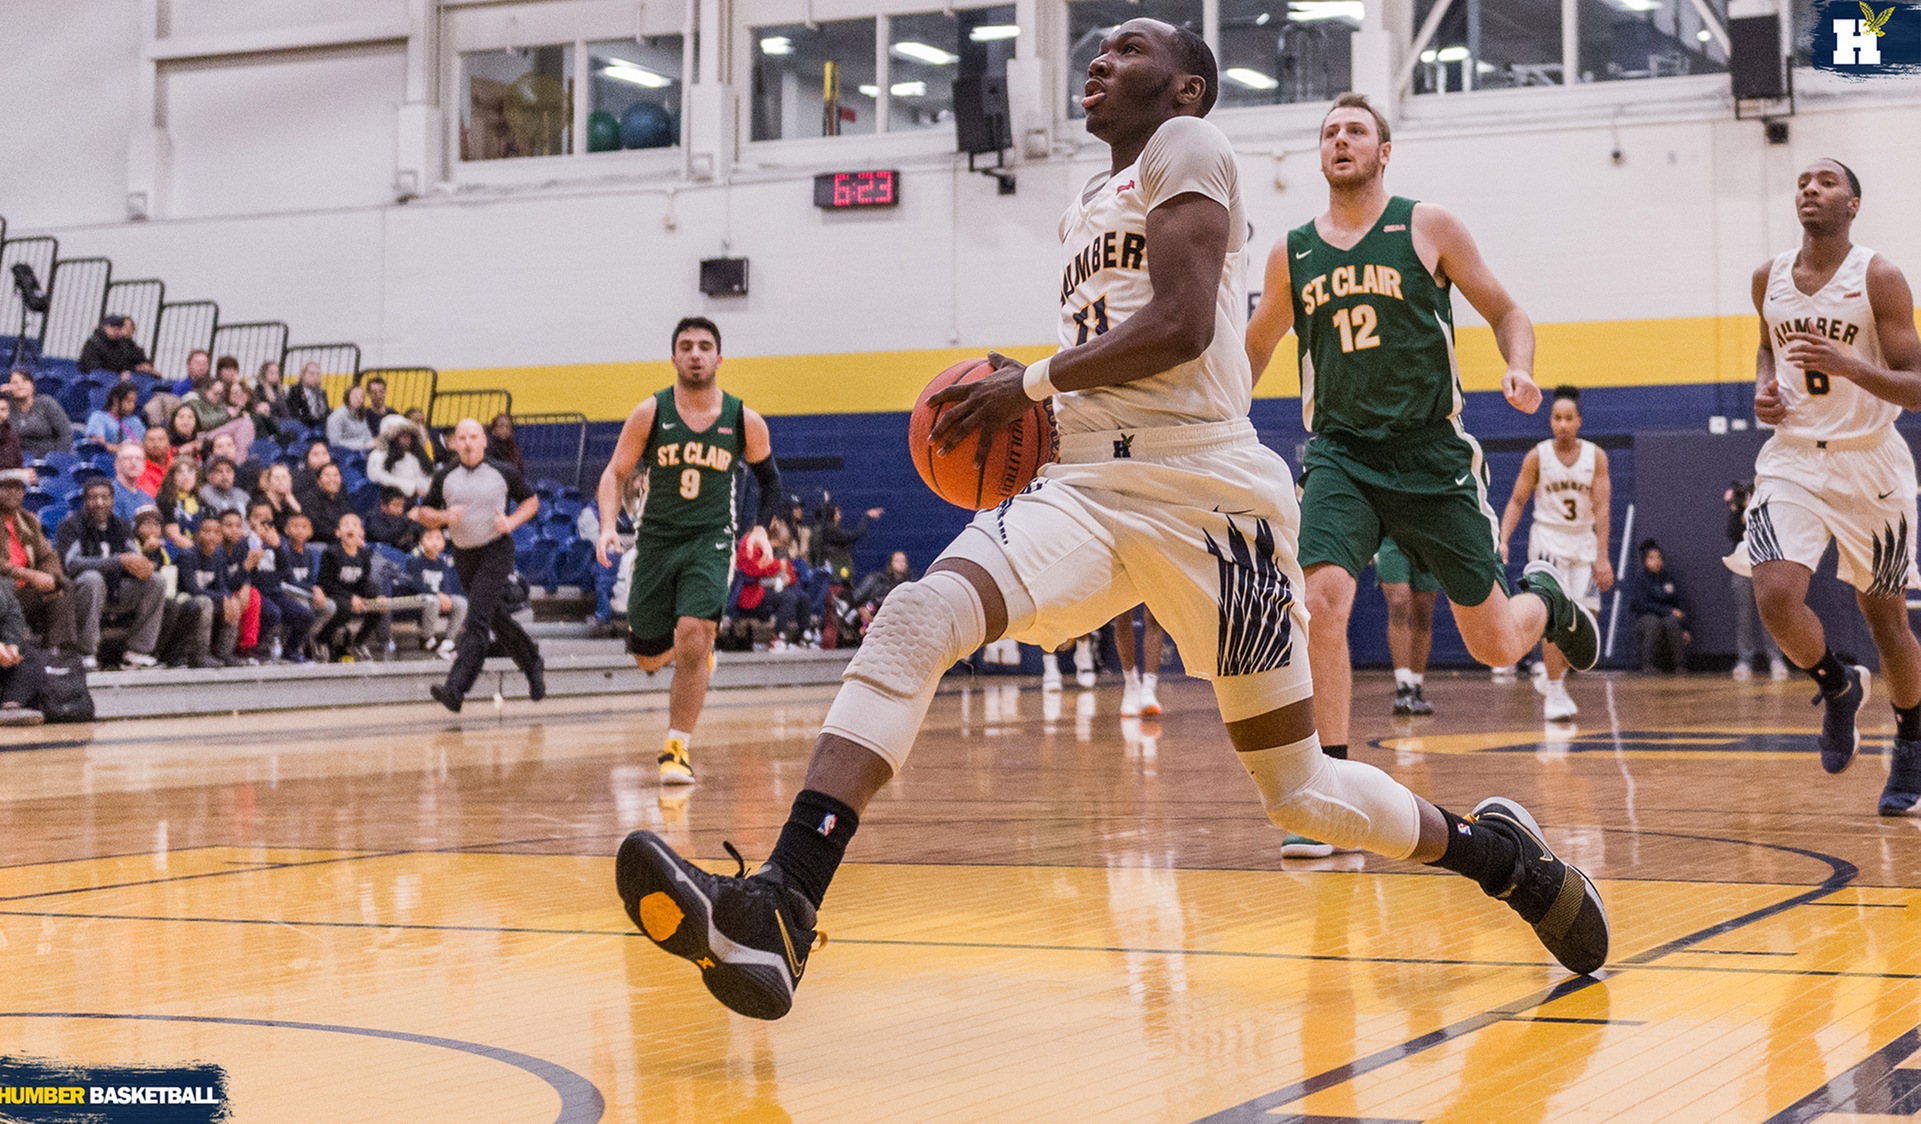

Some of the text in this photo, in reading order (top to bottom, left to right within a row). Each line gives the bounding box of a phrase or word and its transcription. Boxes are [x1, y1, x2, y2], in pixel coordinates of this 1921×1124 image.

[833, 171, 893, 206] 6:23
[1302, 274, 1330, 316] ST.
[1331, 264, 1404, 300] CLAIR
[1332, 304, 1380, 353] 12
[657, 441, 732, 472] ST. CLAIR
[680, 468, 700, 500] 9
[1563, 499, 1577, 521] 3
